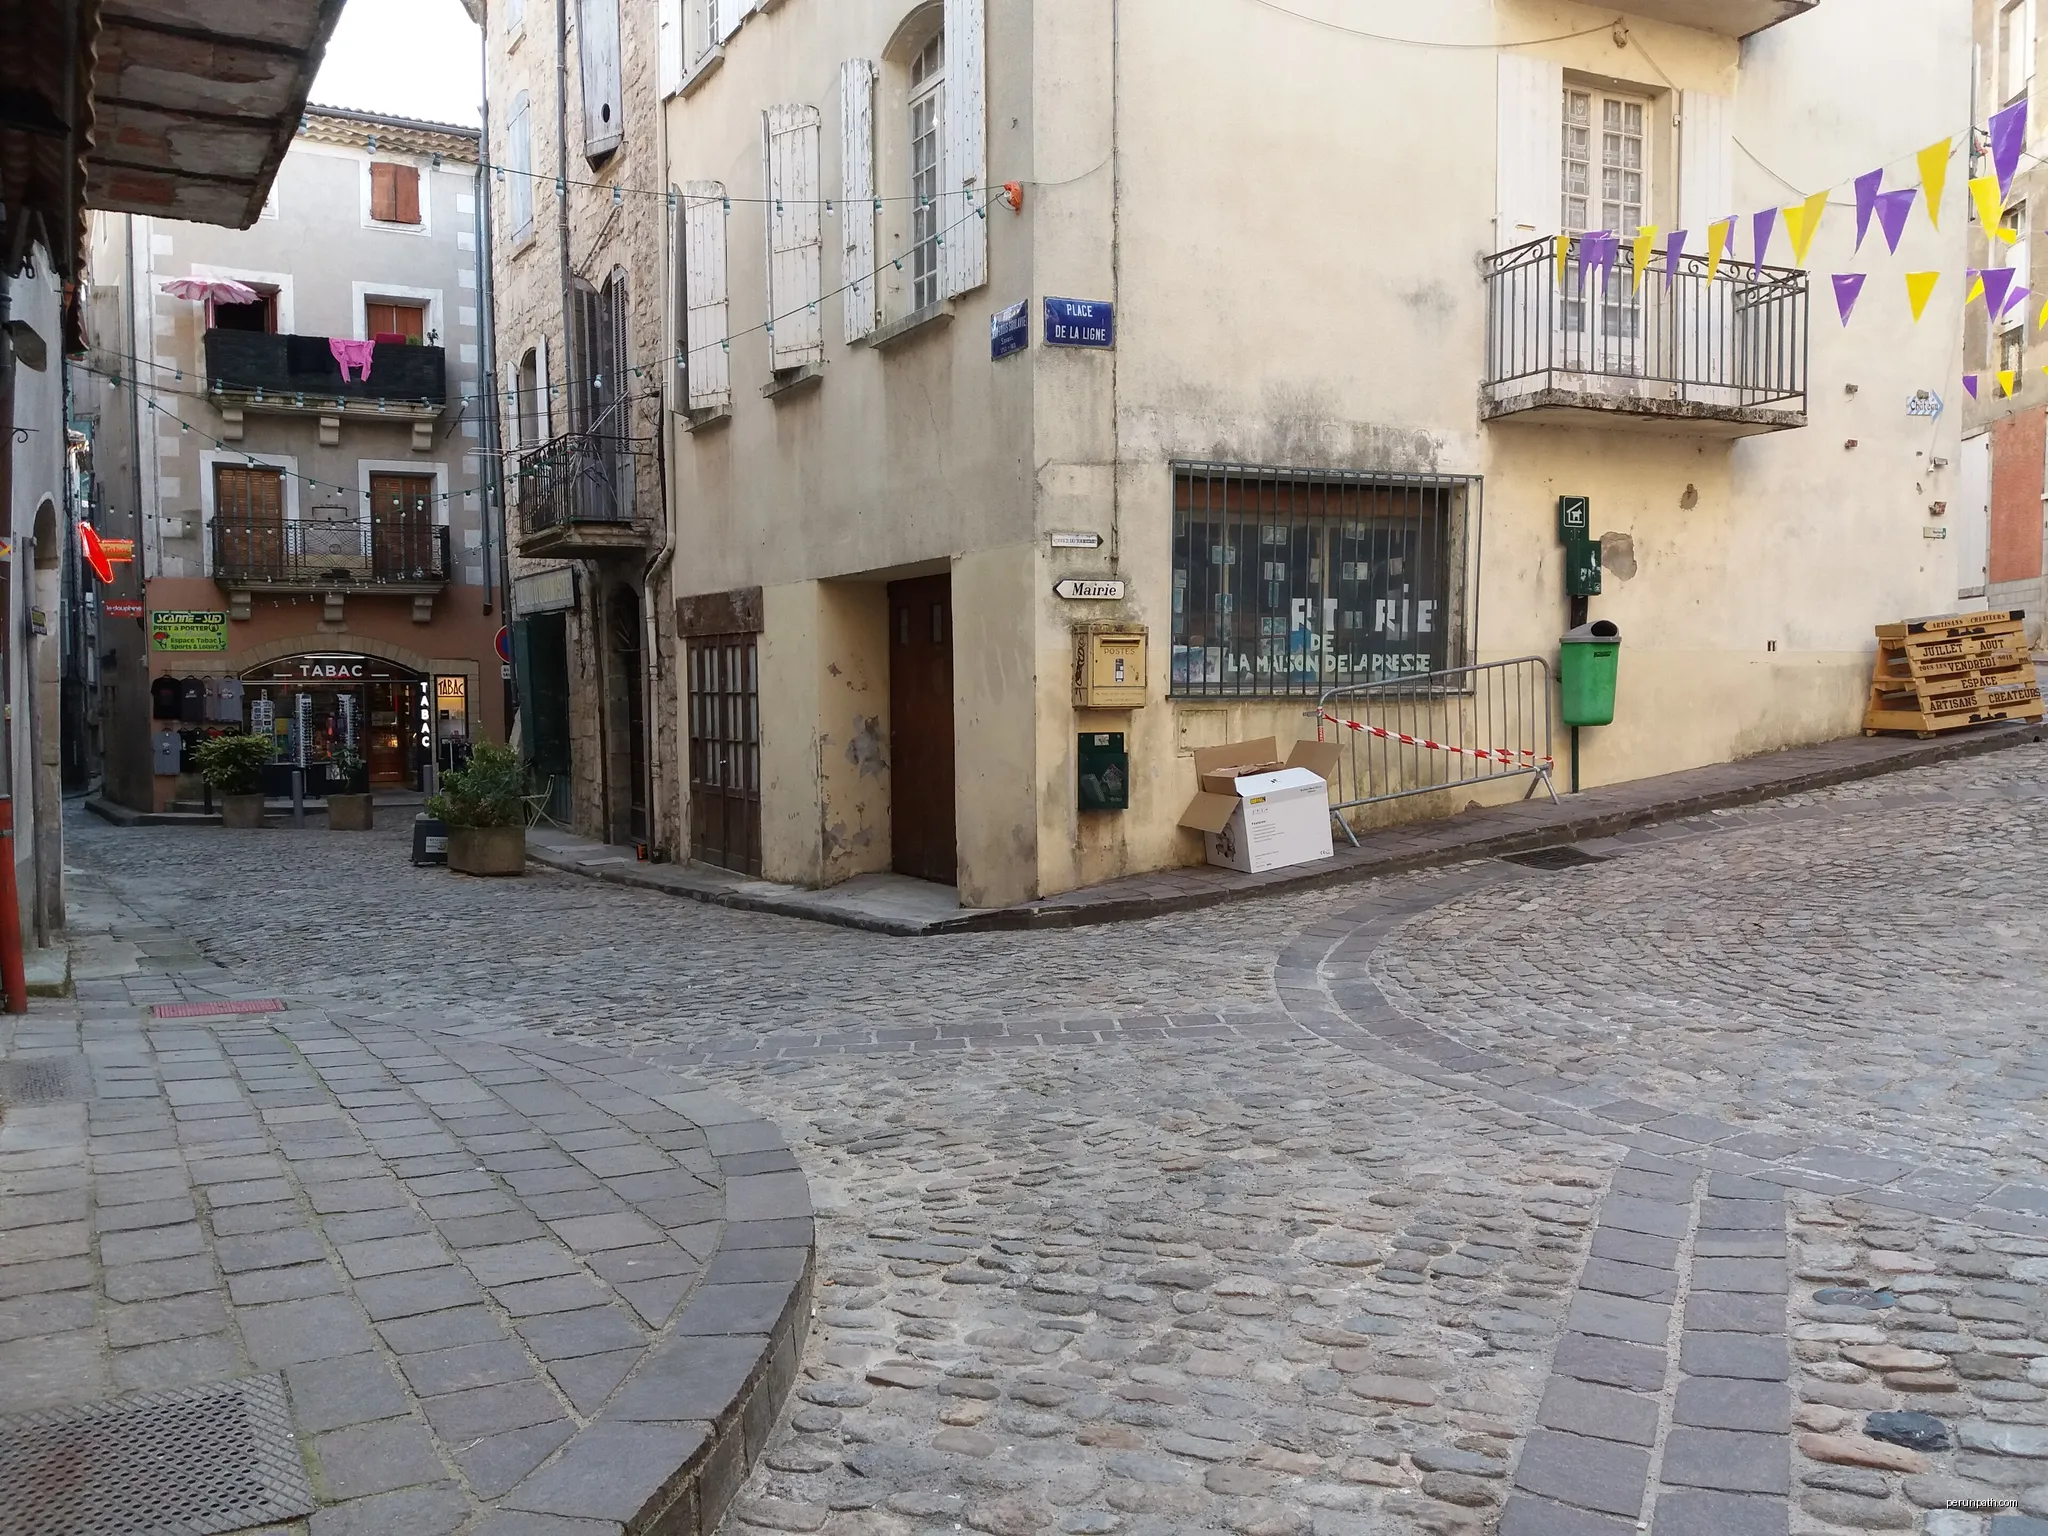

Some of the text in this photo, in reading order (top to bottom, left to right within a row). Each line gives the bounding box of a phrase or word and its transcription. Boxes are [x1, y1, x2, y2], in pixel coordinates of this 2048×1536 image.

[1066, 303, 1093, 318] PLACE
[1055, 325, 1106, 341] DE LA LIGNE
[1072, 583, 1117, 596] Mairie
[1932, 619, 1964, 629] ARTISANS
[1310, 633, 1334, 652] DE
[1922, 643, 1963, 657] JUILLET
[1980, 639, 2005, 651] AOUT
[1104, 647, 1135, 655] POSTES
[300, 664, 363, 677] TABAC
[1227, 653, 1251, 672] LA
[1256, 653, 1319, 673] MAISON
[1371, 653, 1431, 672] PRESSE
[1947, 657, 1997, 672] VENDREDI
[438, 679, 464, 696] TABAC
[1960, 676, 1998, 689] ESPACE
[1930, 687, 2041, 711] ARTISANS CREATEURS
[420, 681, 430, 748] TABAC
